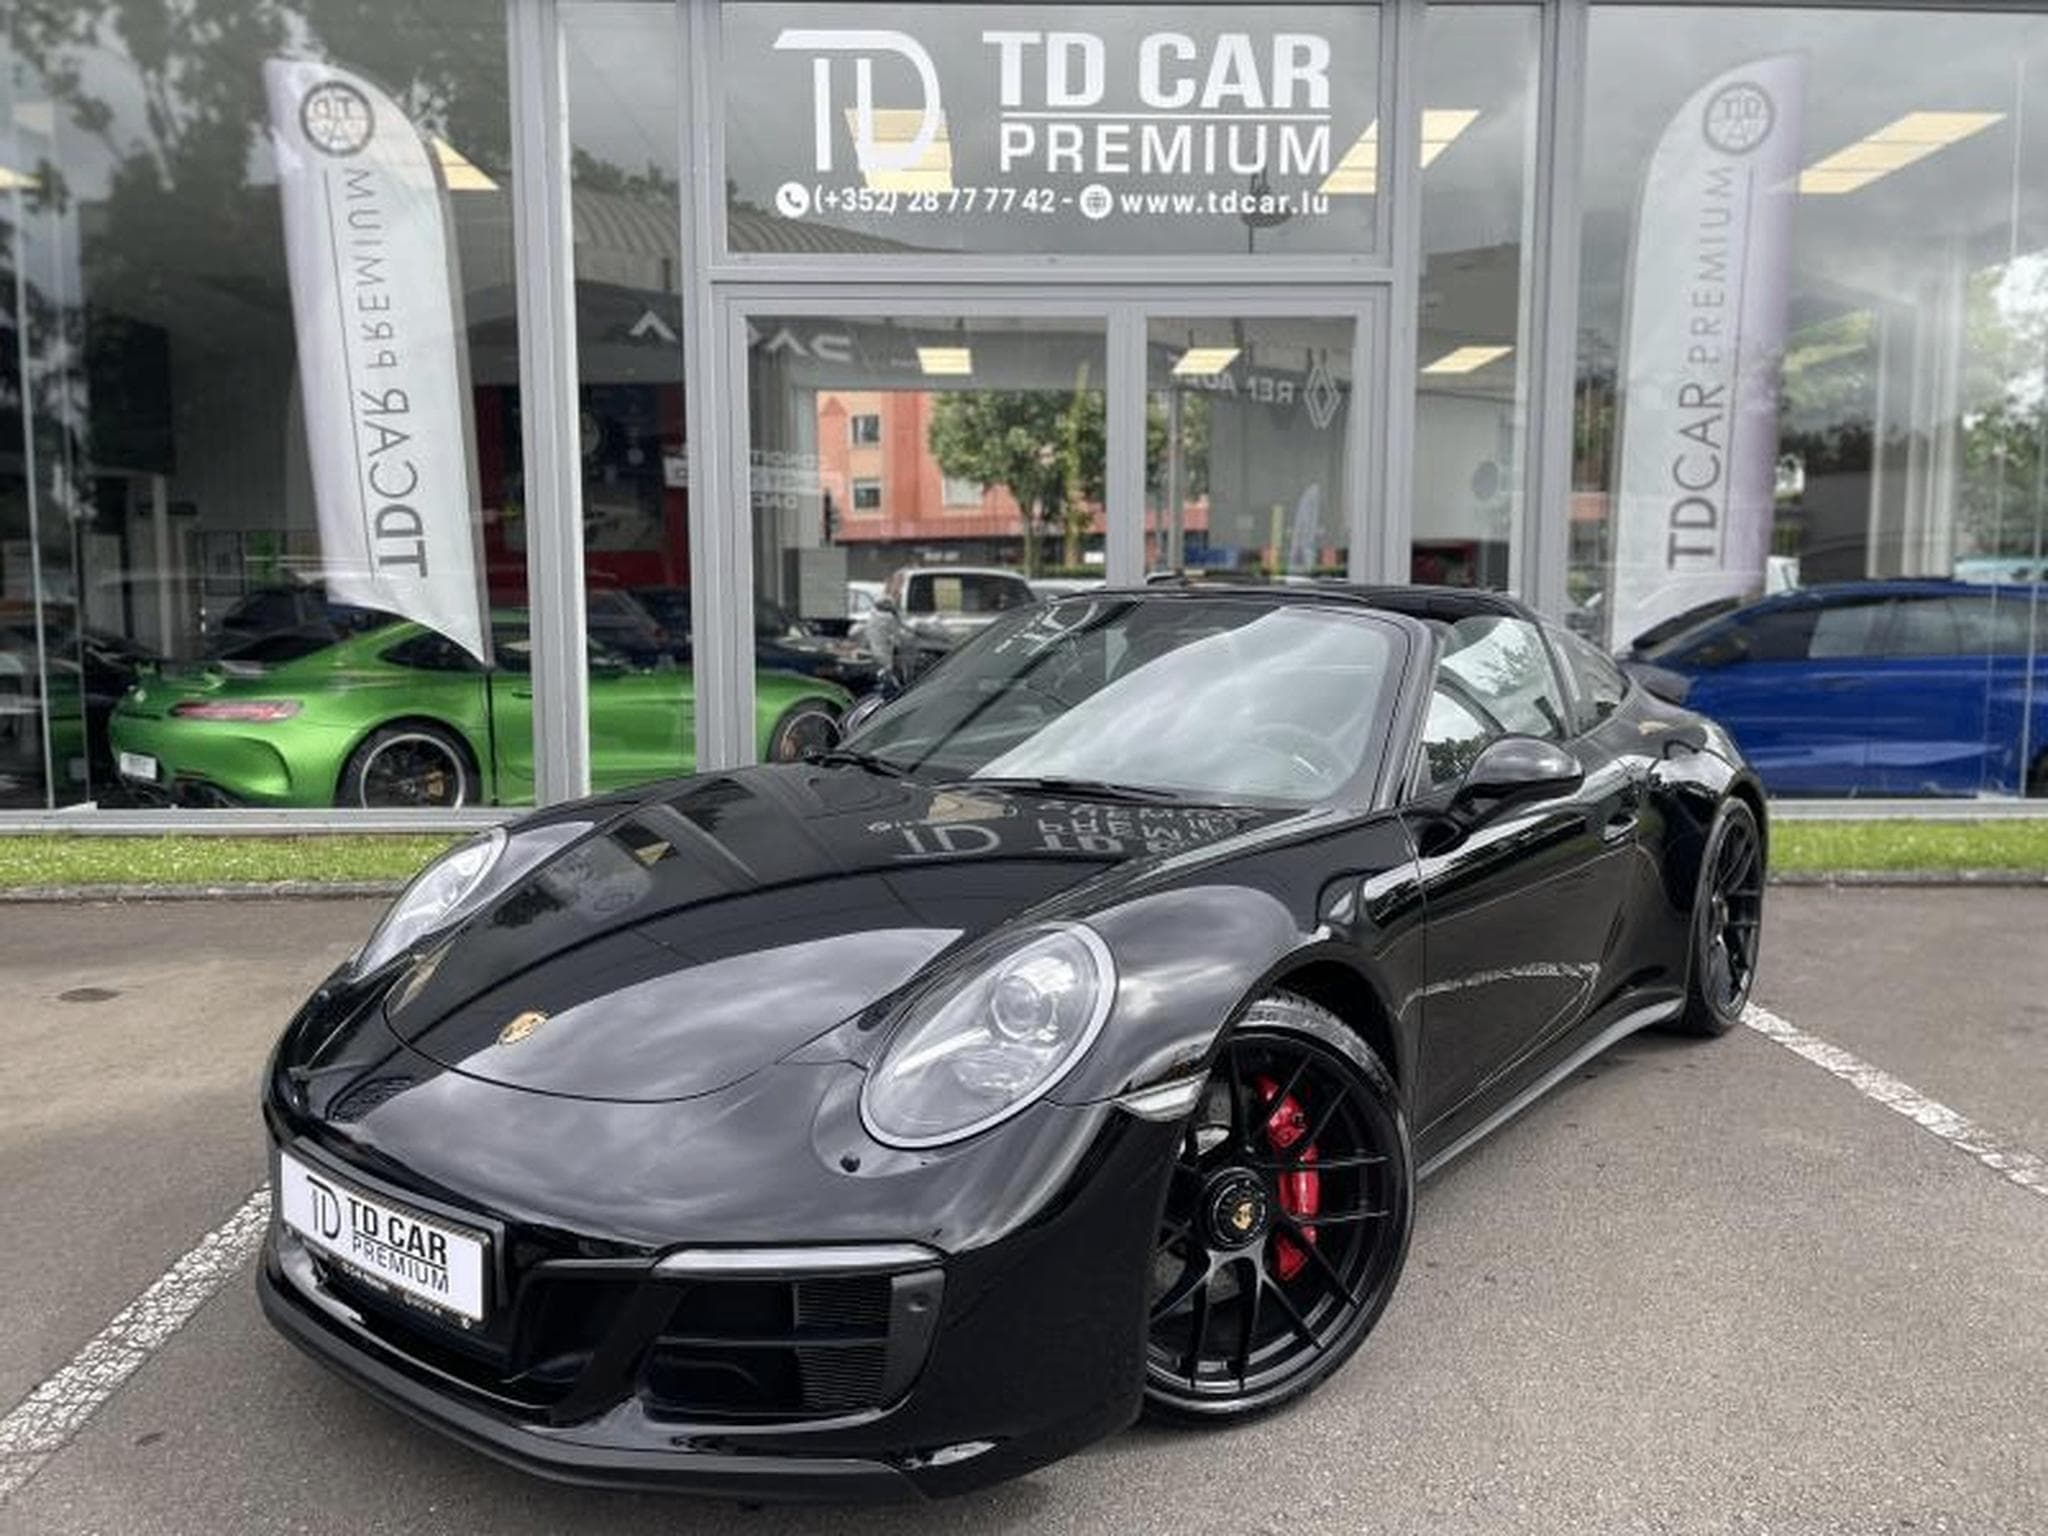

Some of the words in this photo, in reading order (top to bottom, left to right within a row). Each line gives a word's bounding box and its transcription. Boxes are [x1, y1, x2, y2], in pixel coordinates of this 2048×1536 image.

[983, 31, 1106, 107] TD
[1139, 32, 1332, 108] CAR
[1002, 123, 1330, 174] PREMIUM
[815, 184, 898, 214] (+352)
[907, 189, 939, 212] 28
[949, 188, 977, 212] 77
[984, 188, 1016, 212] 77
[1022, 188, 1055, 213] 42
[1120, 190, 1329, 214] www.tdcar.lu
[1688, 166, 1734, 364] PREMIUM
[1668, 382, 1725, 571] TDCAR
[347, 1198, 379, 1237] TD
[387, 1217, 448, 1265] CAR
[352, 1235, 450, 1294] PREMIUM
